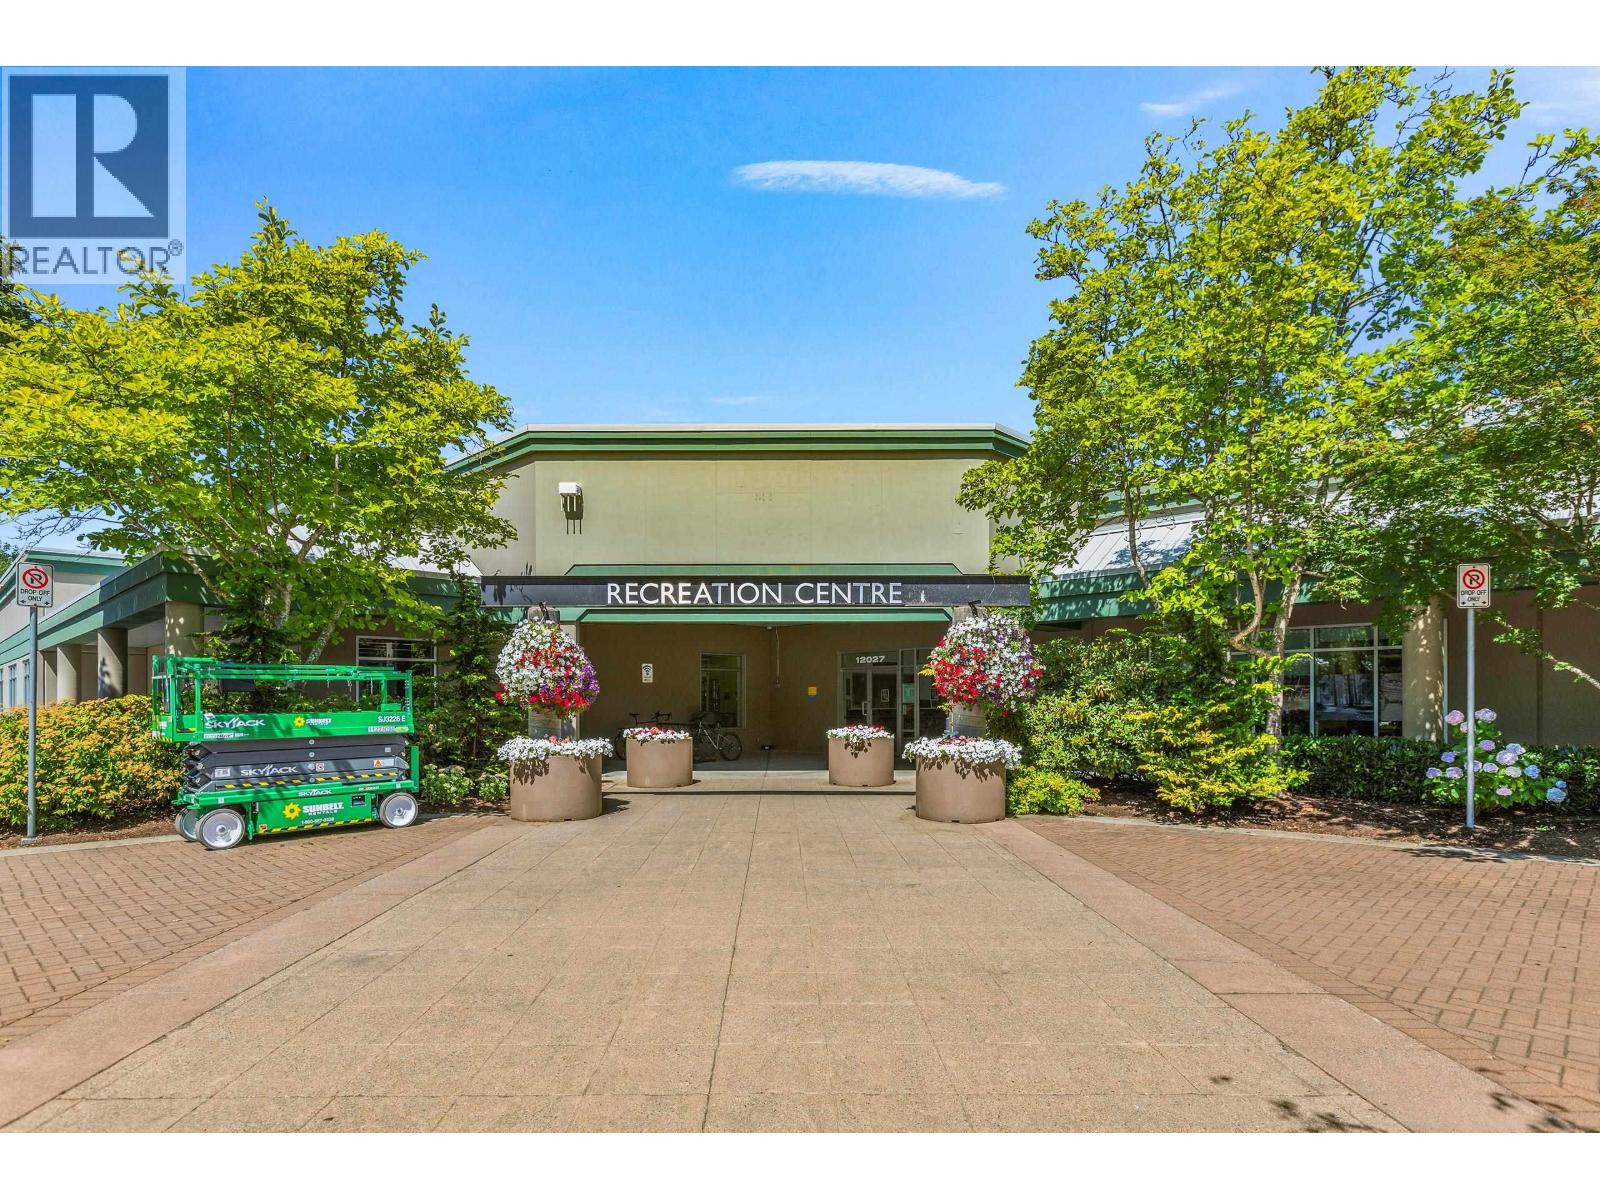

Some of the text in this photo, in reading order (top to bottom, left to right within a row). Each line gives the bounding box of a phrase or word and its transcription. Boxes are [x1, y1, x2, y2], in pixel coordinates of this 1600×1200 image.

[607, 582, 902, 604] RECREATION CENTRE
[855, 655, 885, 664] 12027
[204, 717, 266, 729] SKYJACK
[240, 764, 298, 776] SKYJACK
[298, 788, 333, 797] SKYJACK
